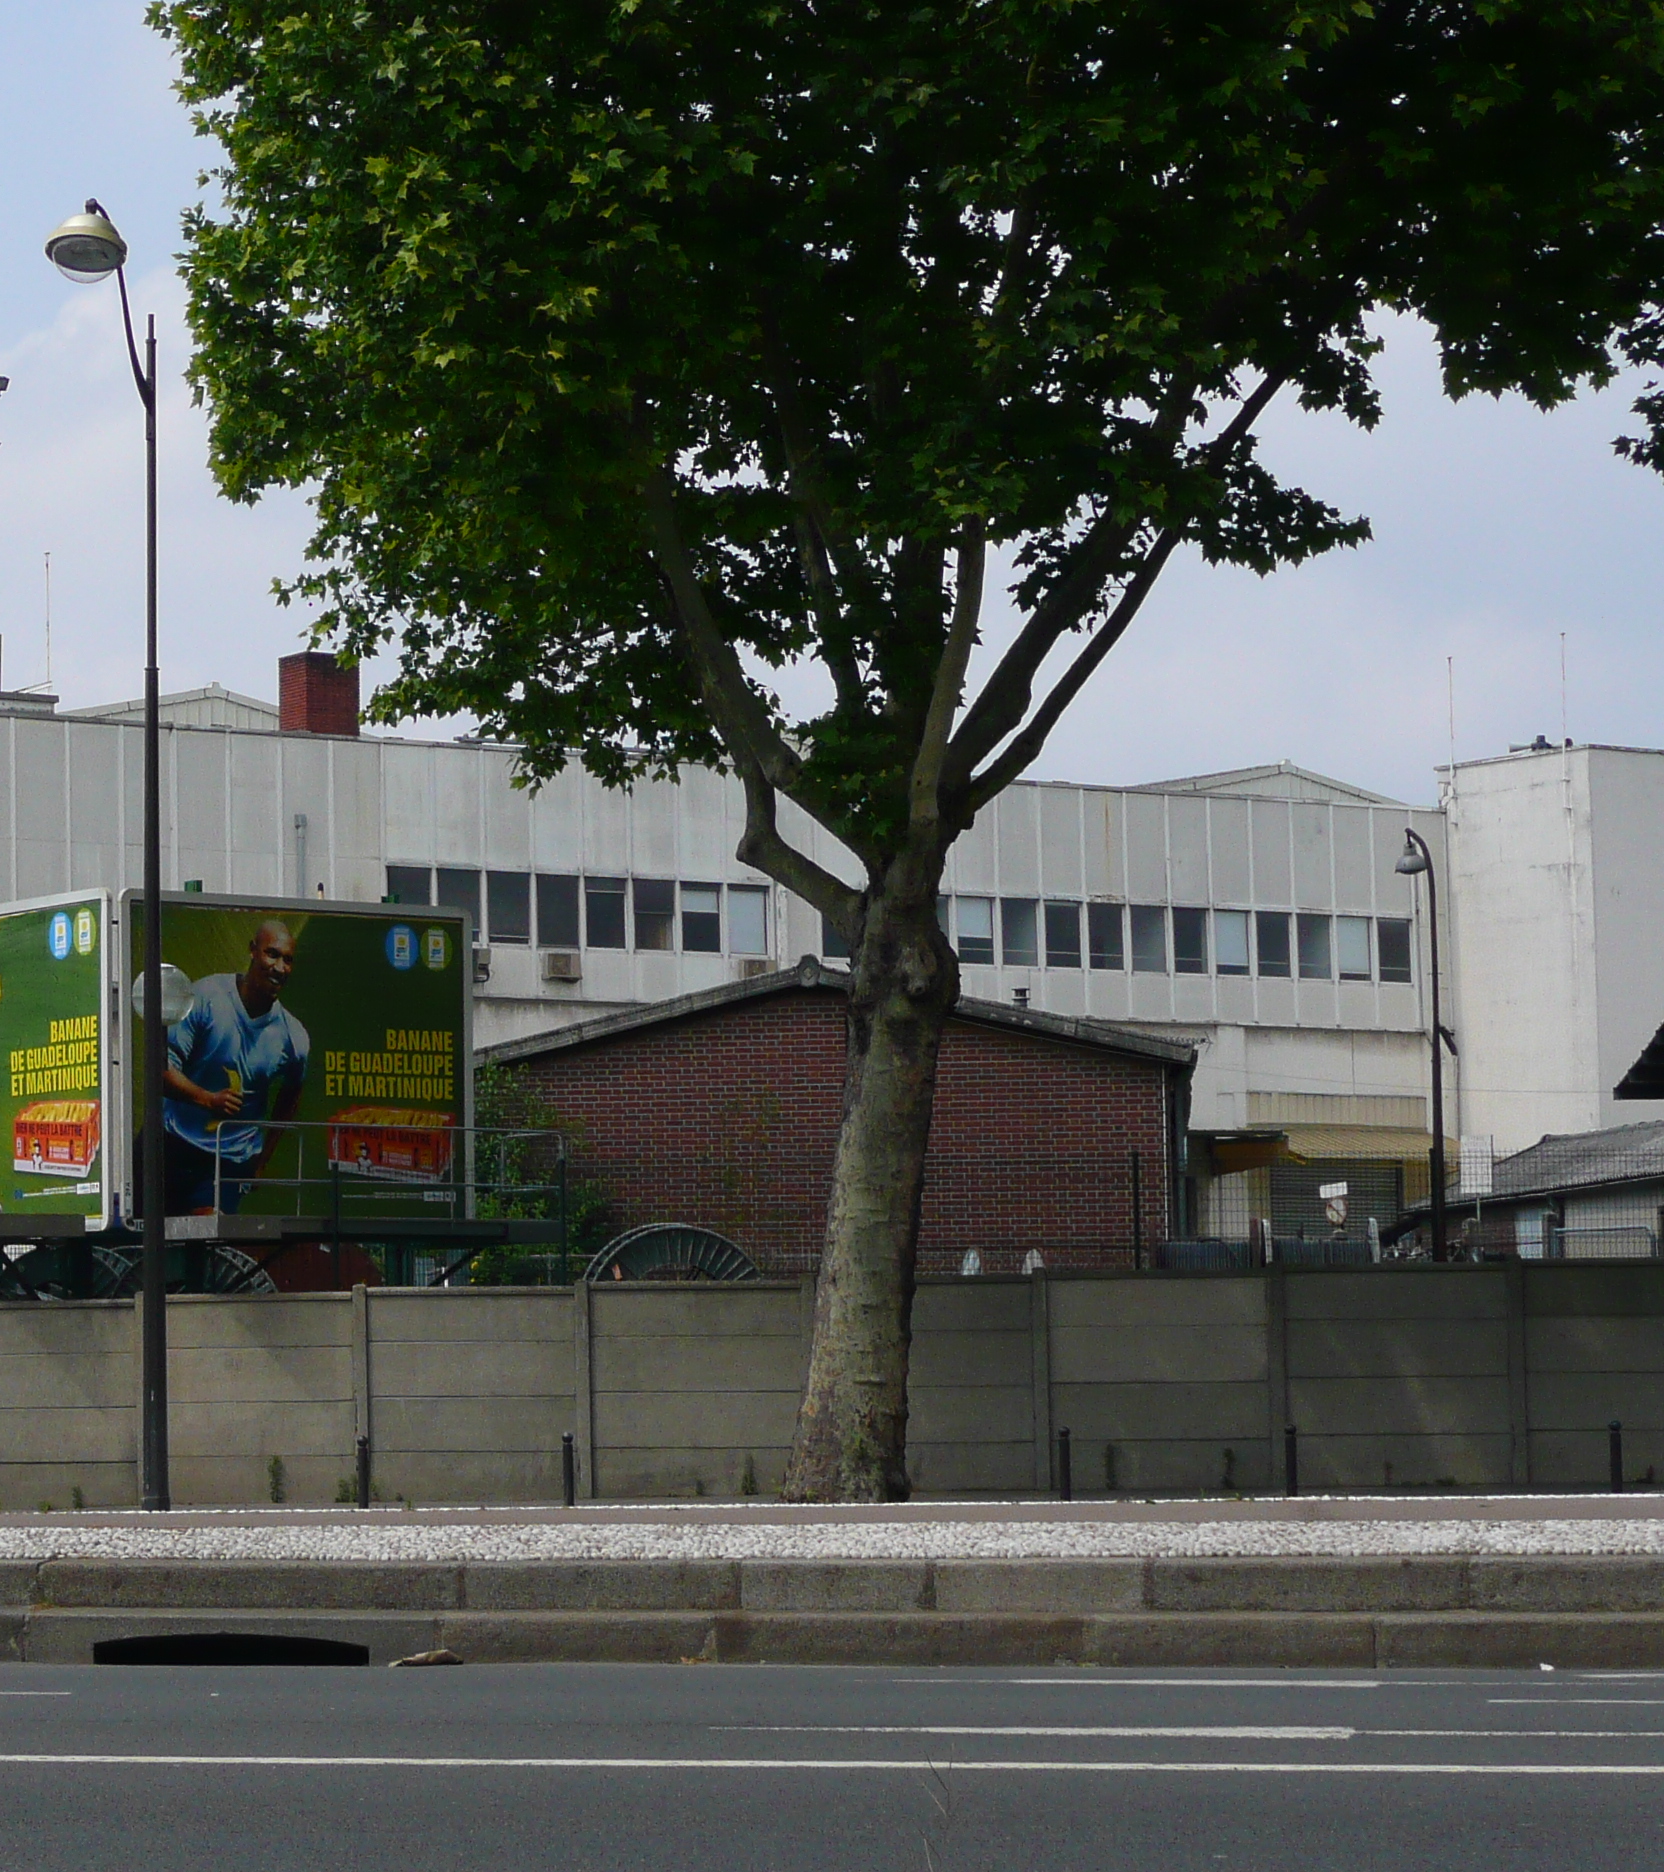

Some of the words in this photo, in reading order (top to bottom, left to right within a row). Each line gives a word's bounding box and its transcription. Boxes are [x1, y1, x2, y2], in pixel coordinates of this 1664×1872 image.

[50, 1015, 97, 1043] BANANE
[386, 1029, 453, 1052] BANANE
[10, 1050, 24, 1072] DE
[26, 1040, 98, 1070] GUADELOUPE
[325, 1051, 346, 1072] DE
[350, 1052, 453, 1076] GUADELOUPE
[11, 1074, 24, 1096] ET
[26, 1064, 98, 1094] MARTINIQUE
[326, 1074, 345, 1096] ET
[348, 1075, 454, 1101] MARTINIQUE
